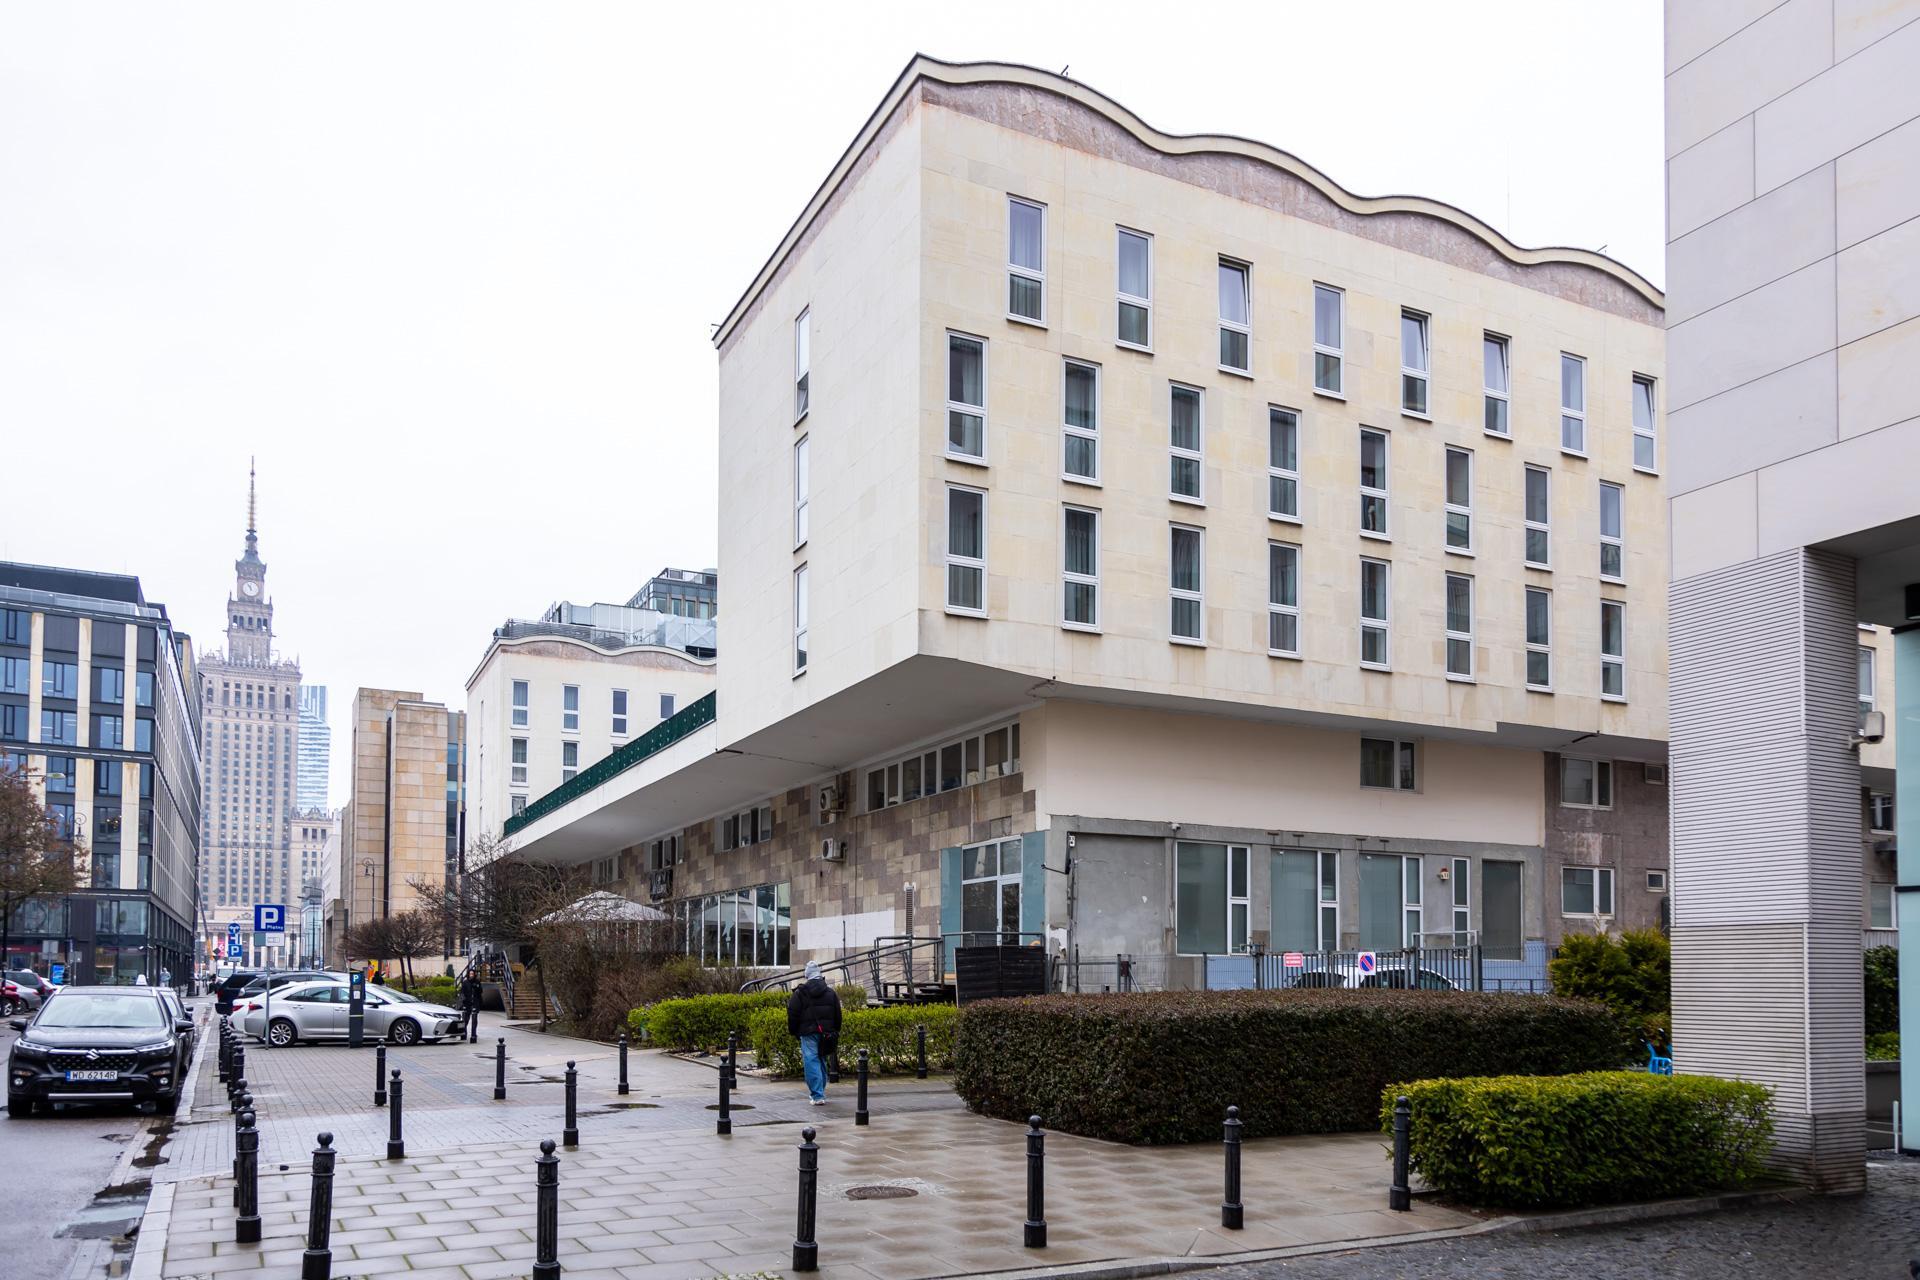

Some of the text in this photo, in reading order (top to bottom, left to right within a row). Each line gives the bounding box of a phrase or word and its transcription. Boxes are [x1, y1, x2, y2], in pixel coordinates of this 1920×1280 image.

[260, 907, 279, 930] P
[231, 946, 239, 956] P
[72, 1071, 85, 1079] WD
